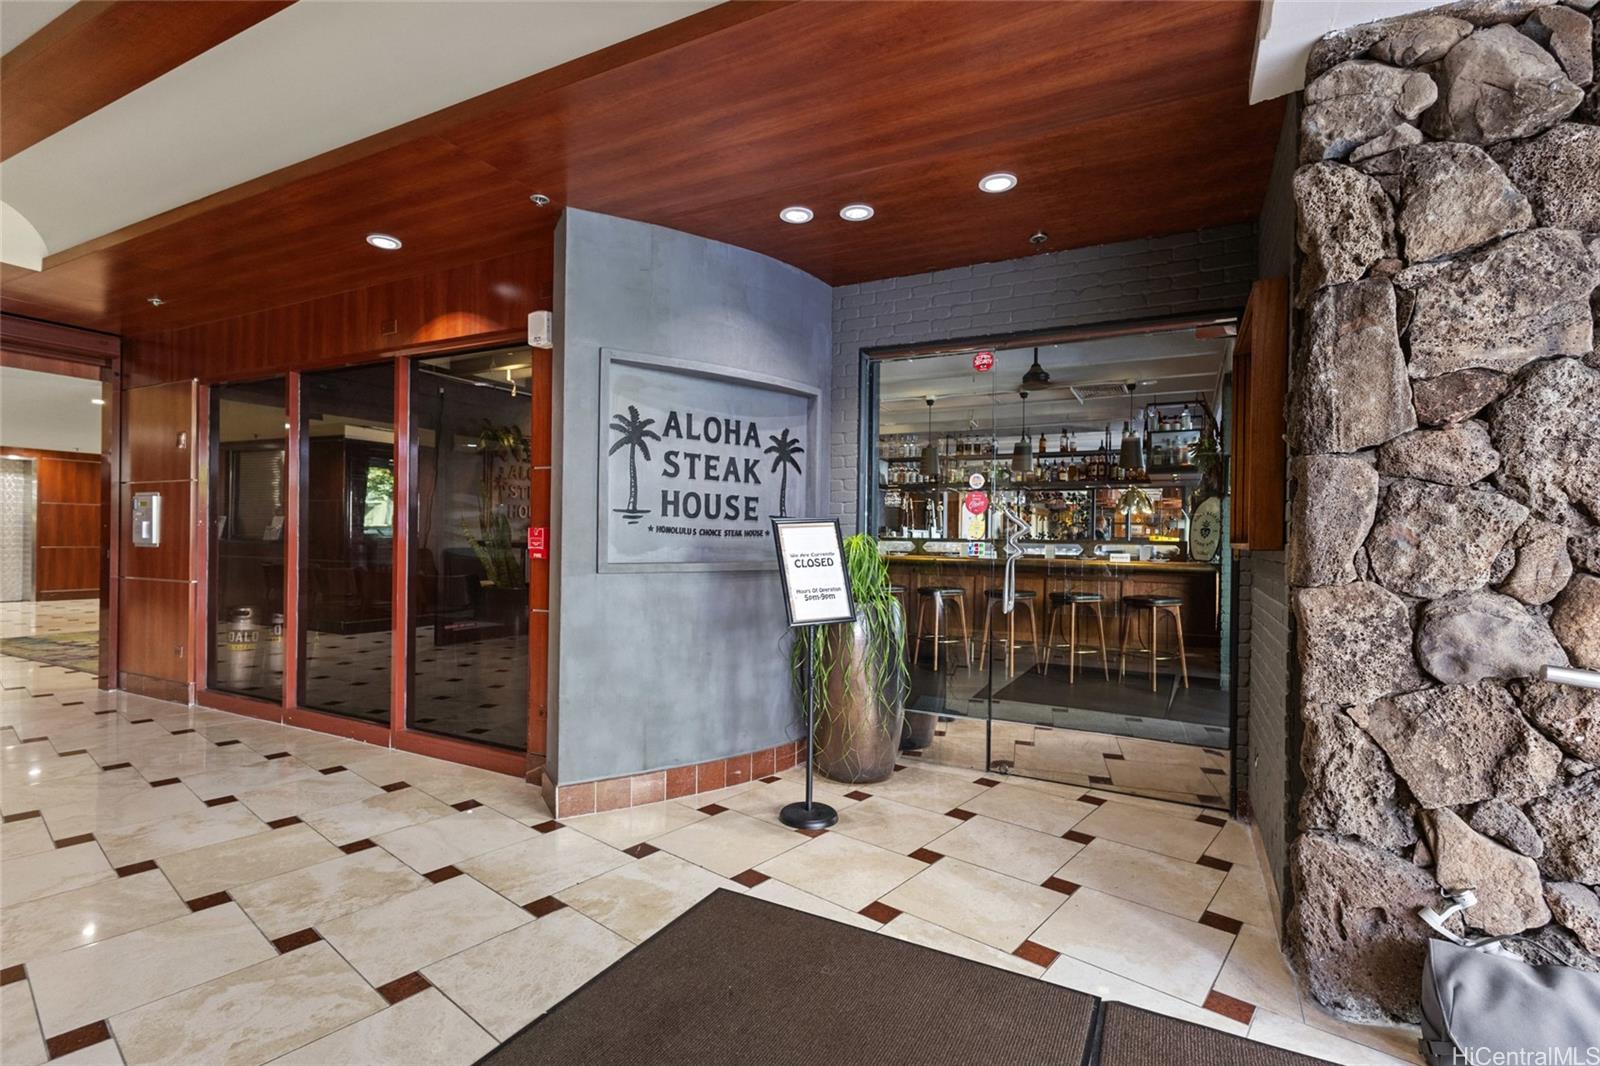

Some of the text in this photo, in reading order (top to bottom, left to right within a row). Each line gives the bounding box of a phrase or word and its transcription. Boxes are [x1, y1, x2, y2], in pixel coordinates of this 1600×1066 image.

[662, 411, 761, 448] ALOHA
[661, 451, 762, 484] STEAK
[661, 490, 759, 521] HOUSE
[699, 529, 722, 537] CHOICE
[724, 529, 743, 537] STEAK
[794, 557, 834, 568] CLOSED
